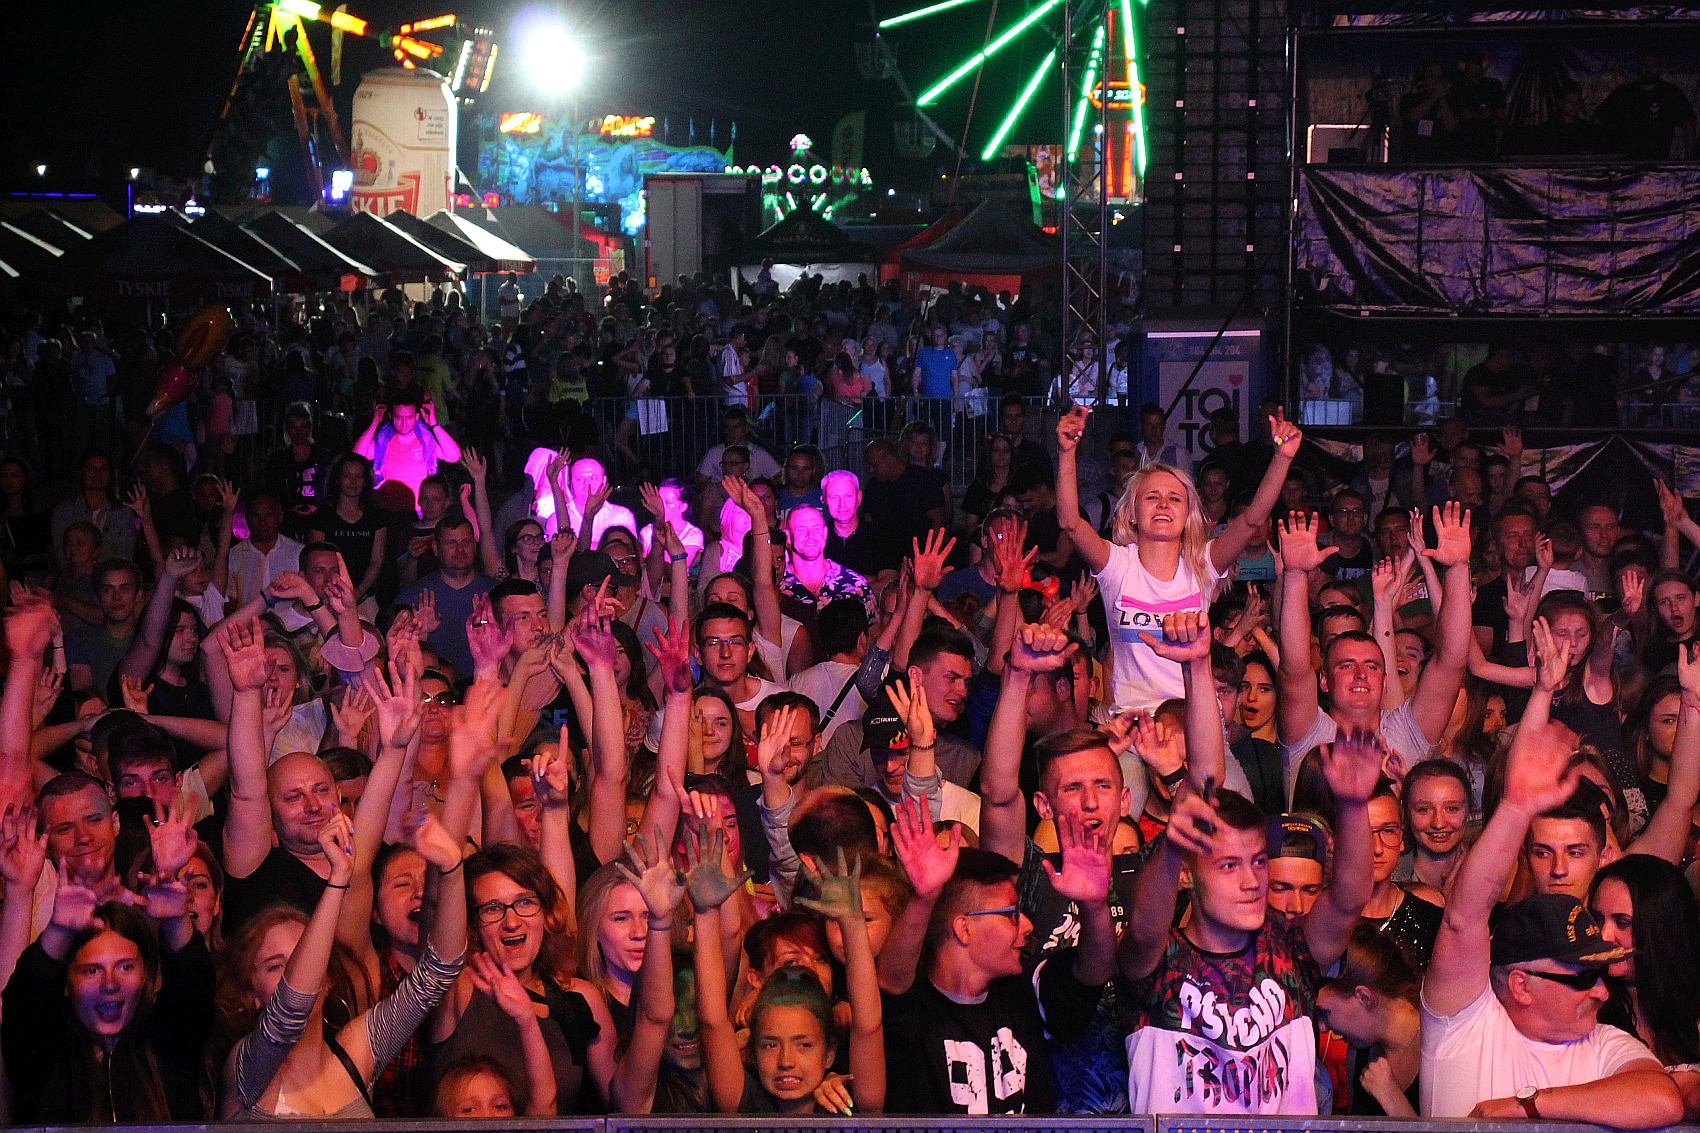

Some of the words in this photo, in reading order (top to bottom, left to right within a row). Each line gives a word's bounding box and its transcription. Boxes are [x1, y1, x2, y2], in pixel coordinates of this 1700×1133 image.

[116, 280, 170, 296] TYSKIE
[1178, 387, 1240, 423] TOI
[1110, 906, 1124, 918] 89
[1179, 978, 1286, 1048] PSYCHO
